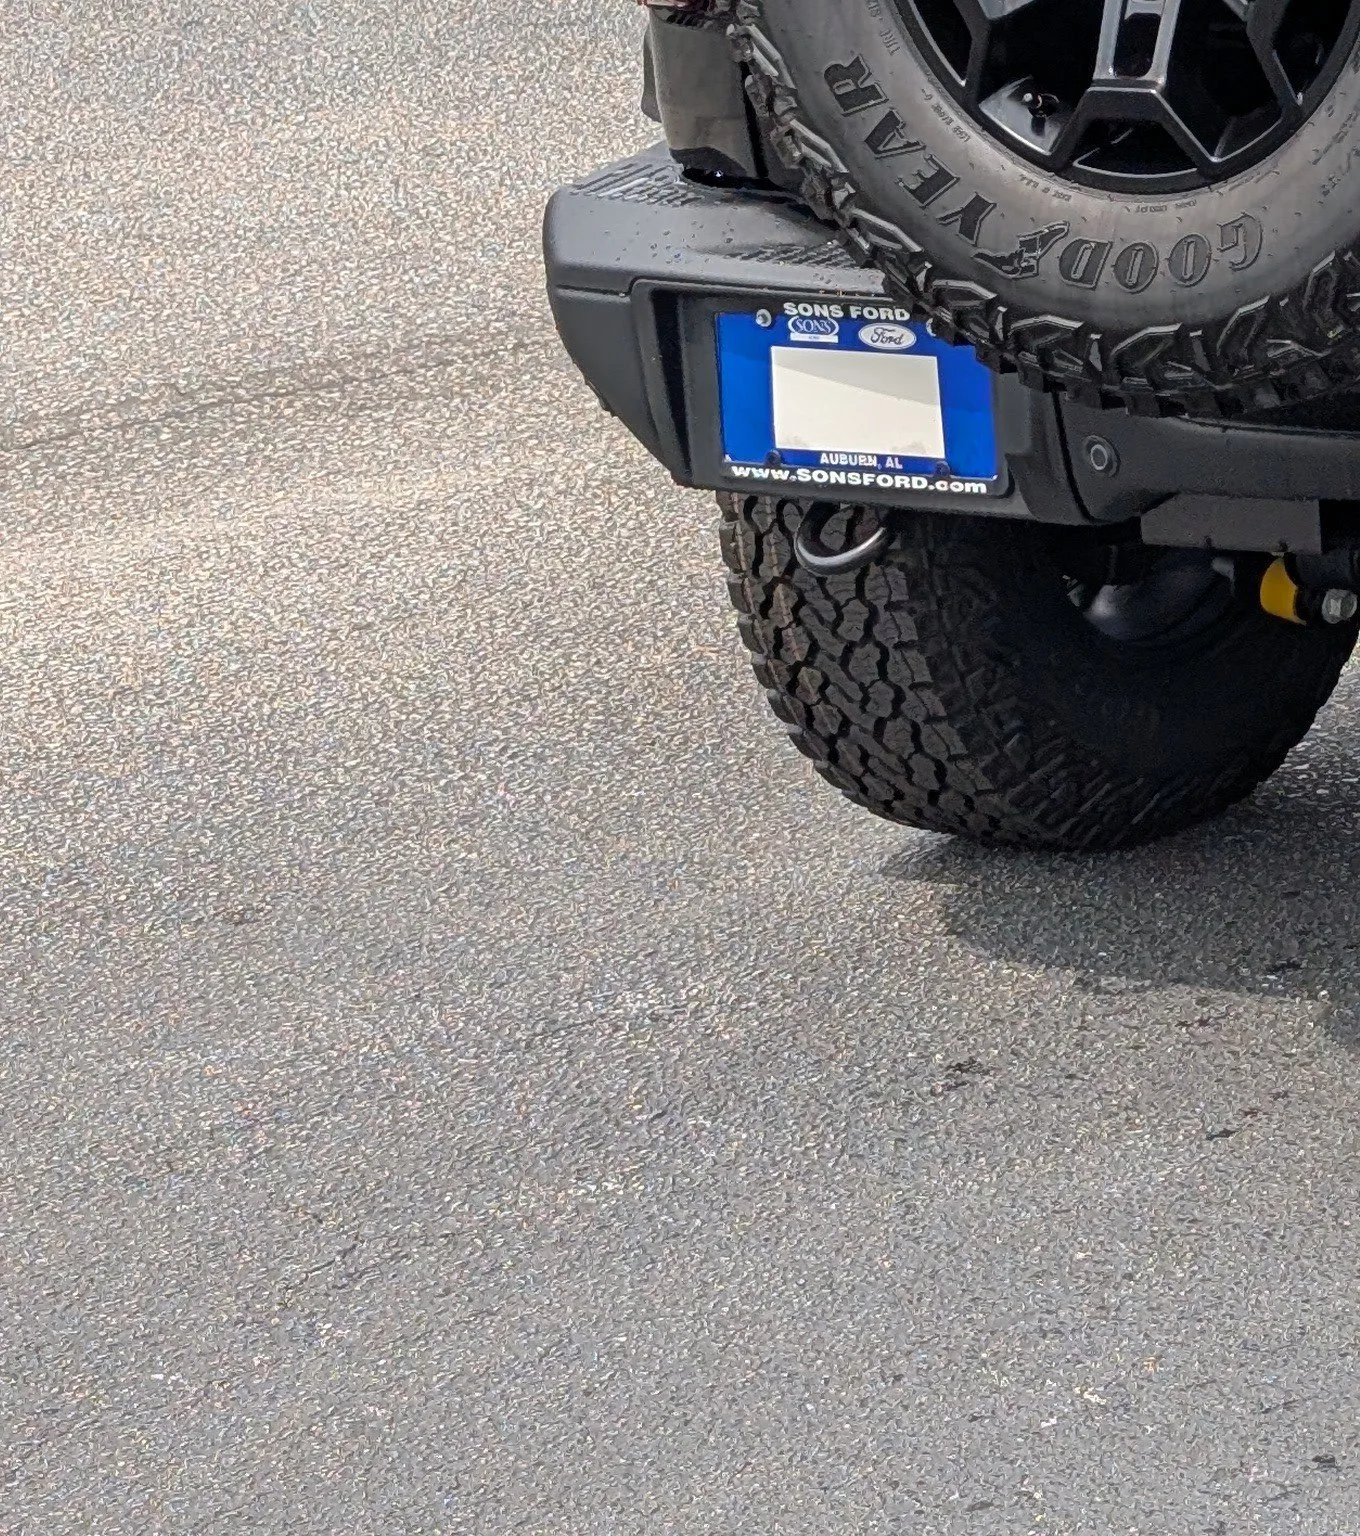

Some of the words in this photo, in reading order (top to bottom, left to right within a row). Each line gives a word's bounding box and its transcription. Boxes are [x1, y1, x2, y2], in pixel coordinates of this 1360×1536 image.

[783, 302, 844, 318] SONS
[850, 305, 911, 322] FORD
[794, 317, 832, 335] SONS
[870, 326, 904, 346] Ford
[819, 452, 882, 470] AUBURN,
[885, 458, 904, 470] AL
[731, 466, 988, 494] www.SONSFORD.com
